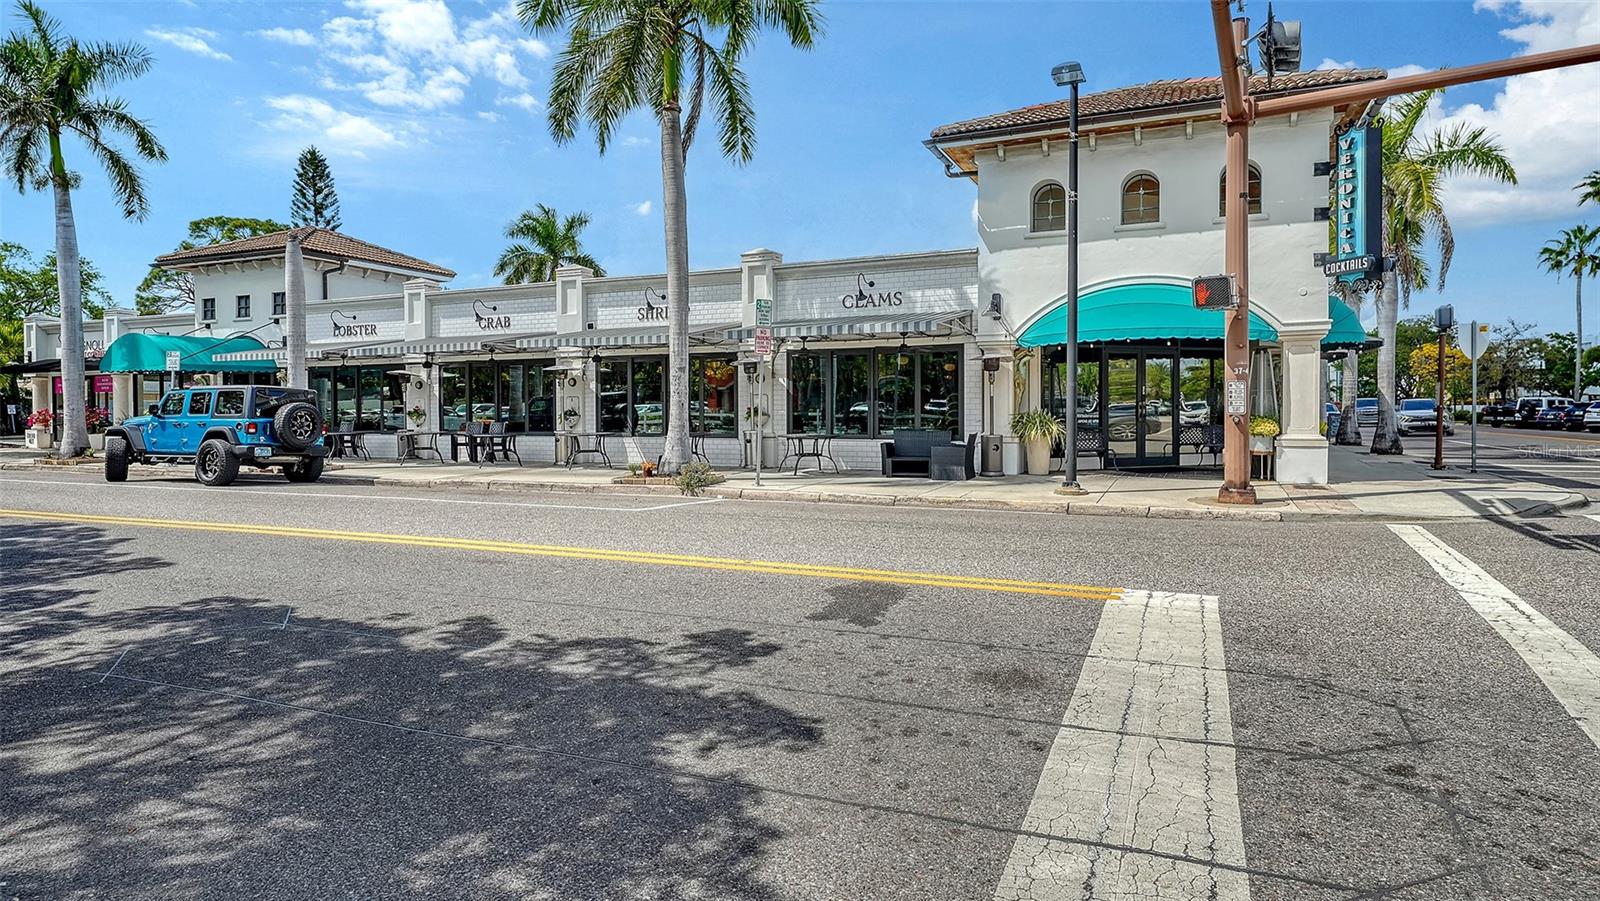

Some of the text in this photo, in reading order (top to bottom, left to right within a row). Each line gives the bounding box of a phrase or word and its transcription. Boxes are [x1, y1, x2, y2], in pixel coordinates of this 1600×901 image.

[1338, 137, 1356, 254] VERONICA
[1325, 257, 1368, 274] COCKTAILS
[842, 291, 902, 309] CLAMS
[333, 324, 377, 337] LOBSTER
[478, 316, 511, 330] CRAB
